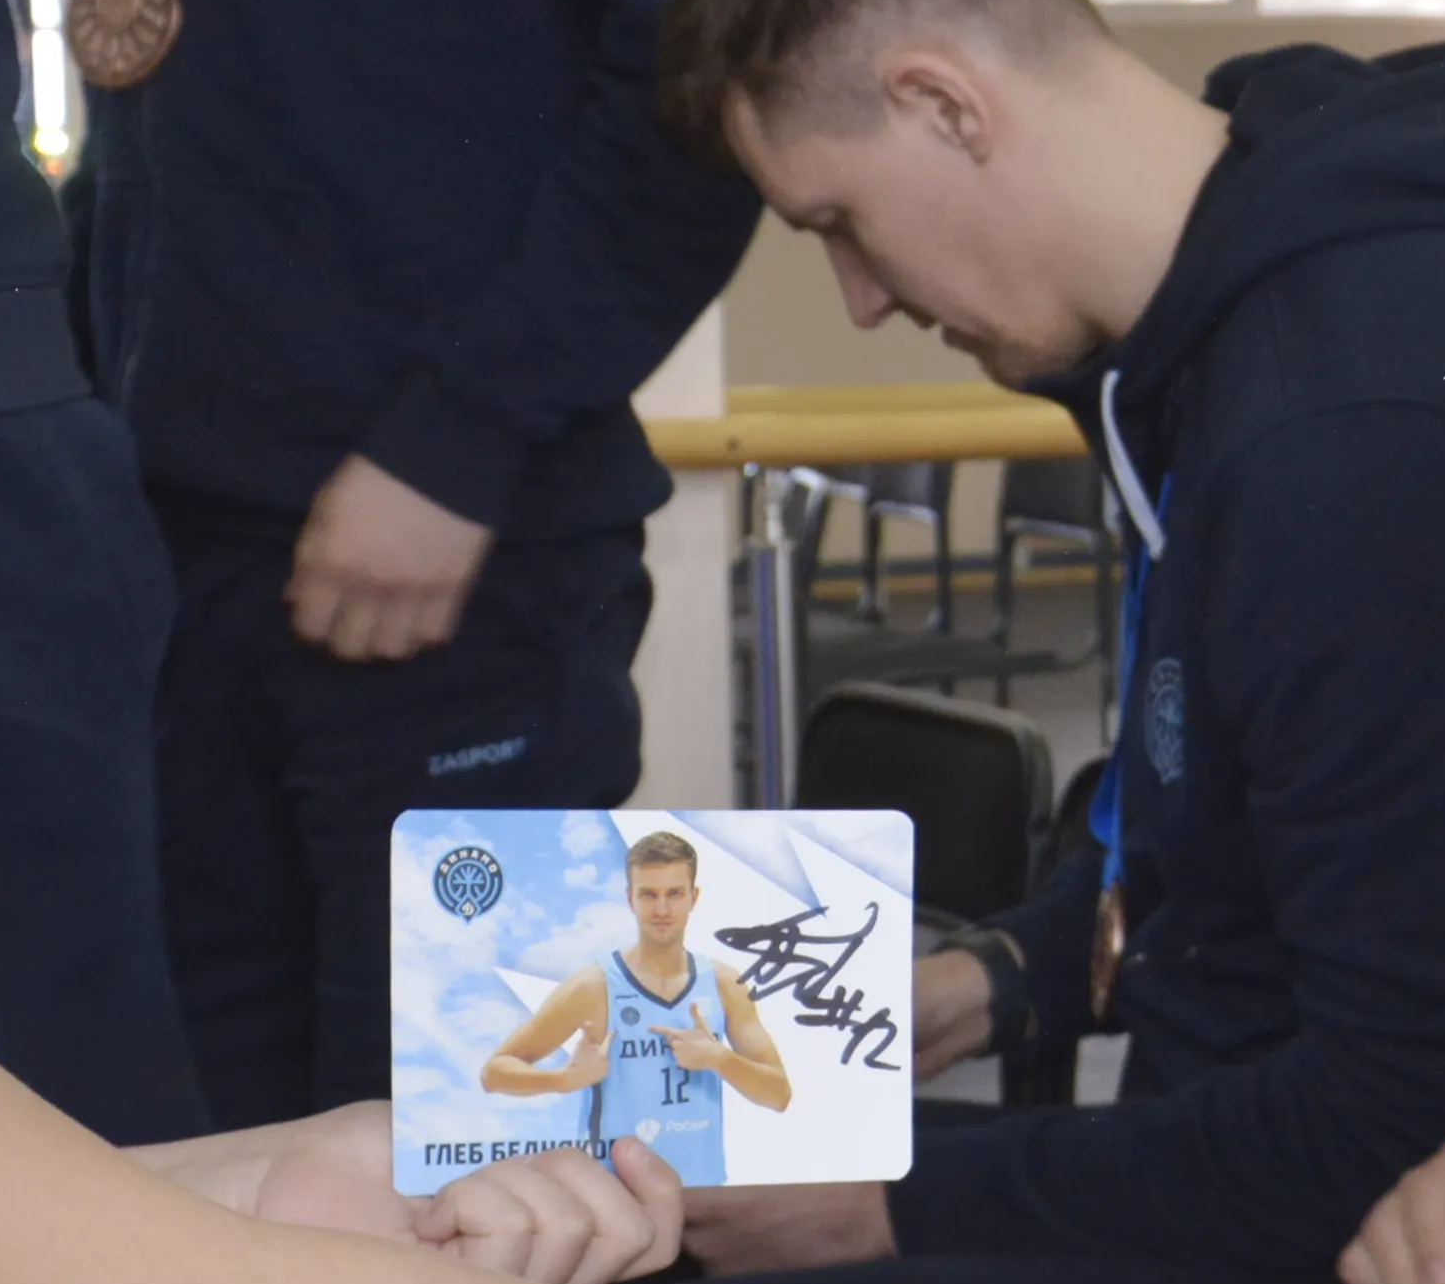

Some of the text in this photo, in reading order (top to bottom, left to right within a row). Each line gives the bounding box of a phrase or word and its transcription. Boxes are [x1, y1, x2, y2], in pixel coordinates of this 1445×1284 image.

[439, 849, 499, 874] ДИНАМО
[660, 1066, 690, 1106] 12
[425, 1142, 483, 1165] ГЛЕБ
